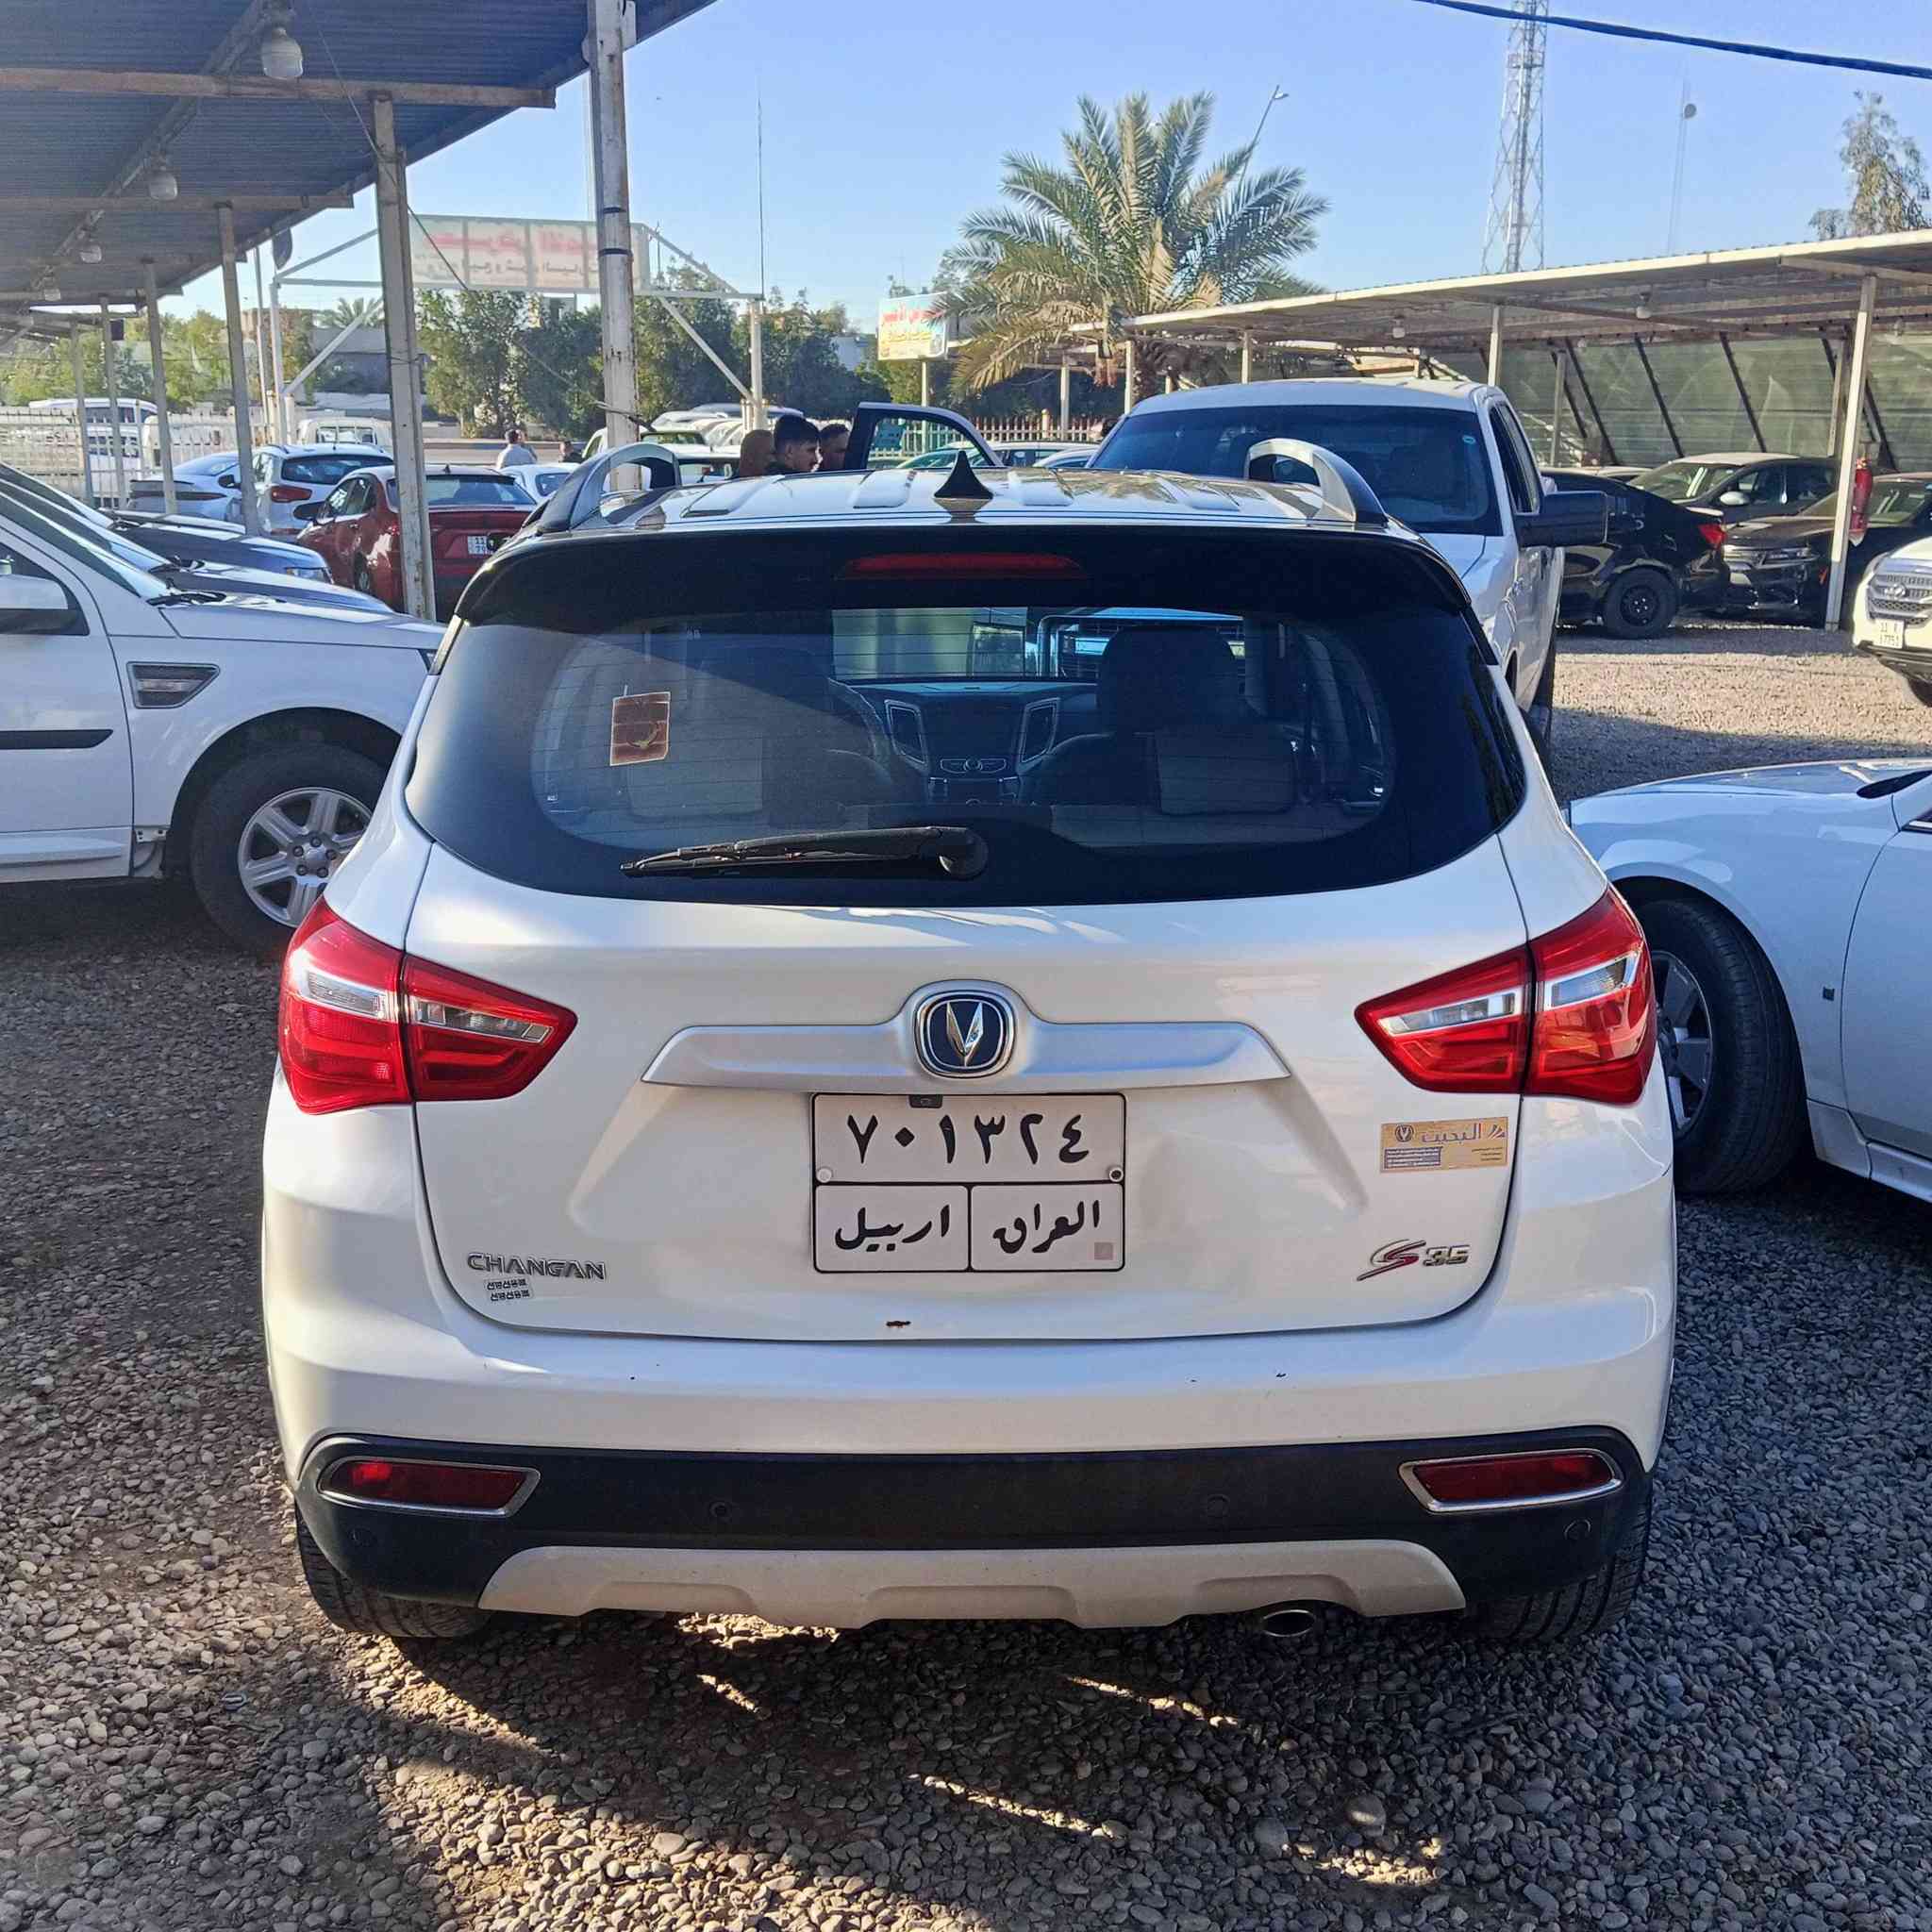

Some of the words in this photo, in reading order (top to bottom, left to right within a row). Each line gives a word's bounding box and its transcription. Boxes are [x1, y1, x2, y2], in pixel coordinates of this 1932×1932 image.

[846, 1113, 1090, 1165] ٧٠١٣٢٤
[834, 1204, 951, 1253] اربيل
[992, 1199, 1101, 1254] العراق
[466, 1252, 607, 1281] CHANGAN
